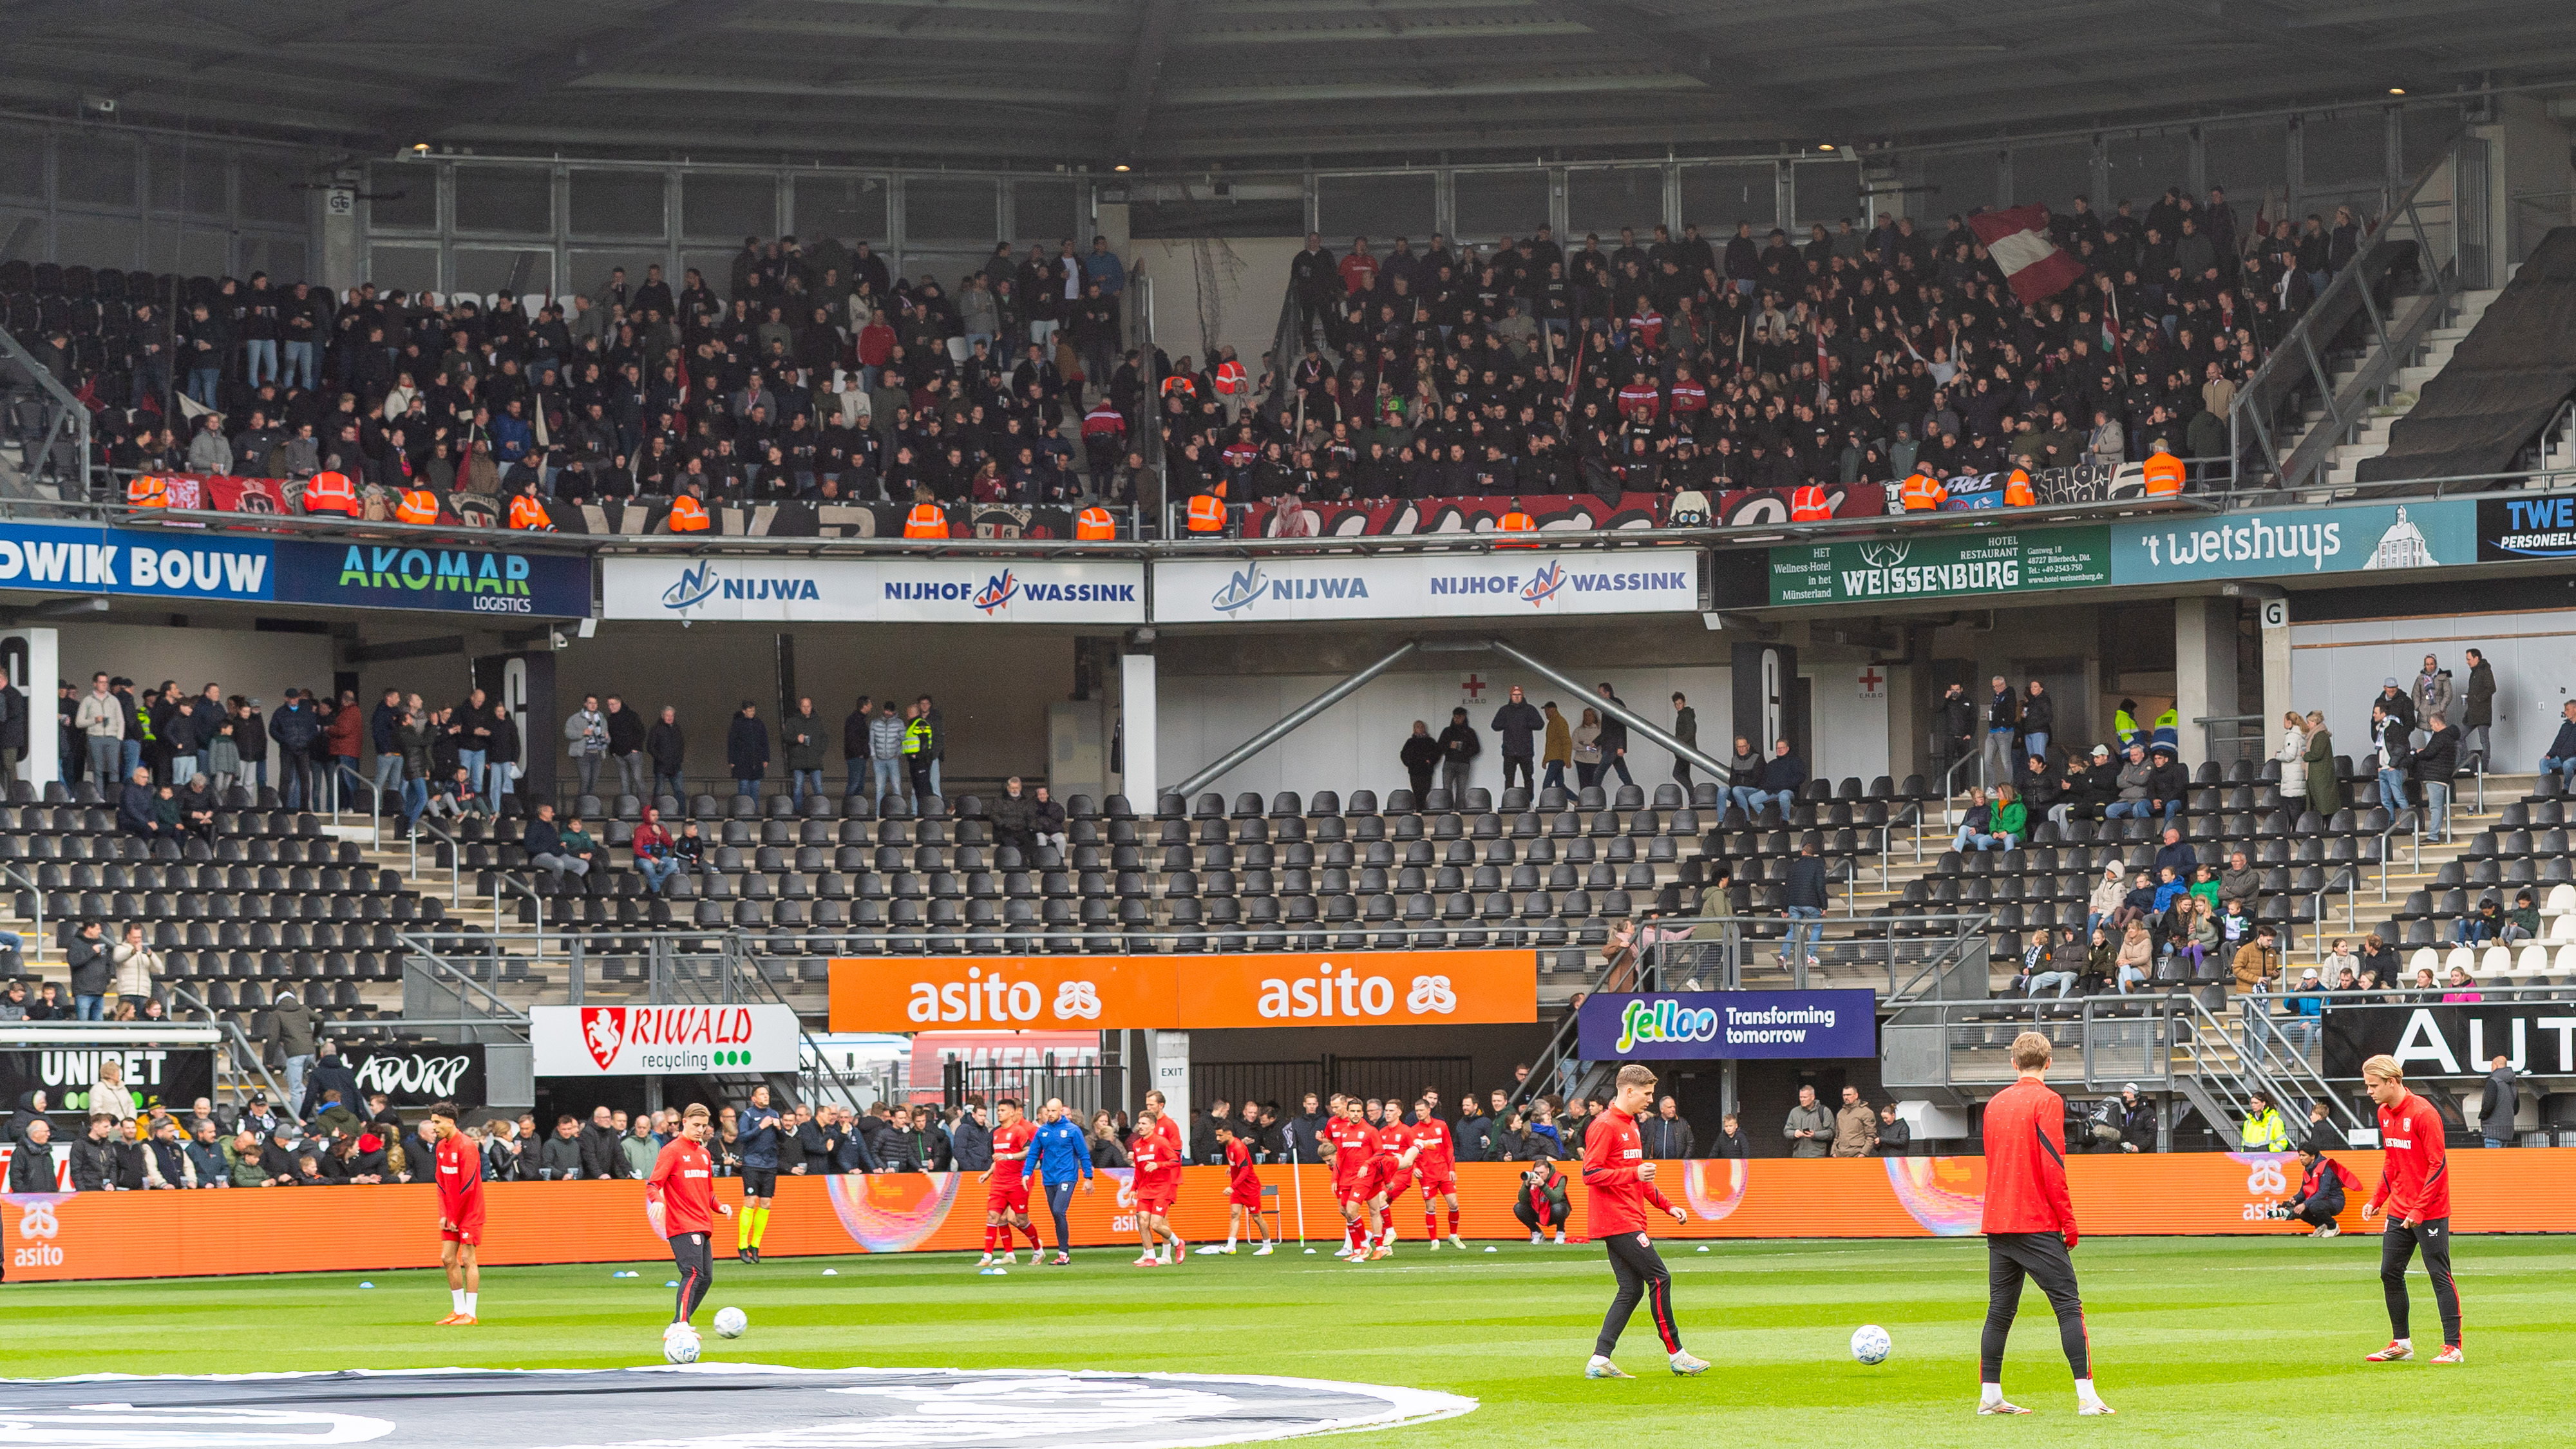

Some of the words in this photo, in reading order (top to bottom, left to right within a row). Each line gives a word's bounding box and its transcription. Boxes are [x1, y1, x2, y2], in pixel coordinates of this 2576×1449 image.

[1944, 472, 1999, 493] FREE
[1988, 536, 2018, 546] HOTEL
[2168, 518, 2340, 571] wetshuys
[1814, 547, 1831, 558] HET
[1960, 547, 2018, 560] RESTAURANT
[130, 544, 267, 592] BOUW
[339, 545, 531, 596] AKOMAR
[1774, 561, 1831, 574] Wellness-Hotel
[1841, 560, 2019, 596] WEISSENBURG
[723, 578, 820, 600] NIJWA
[1273, 578, 1369, 600] NIJWA
[1430, 576, 1519, 594] NIJHOF
[1571, 572, 1686, 591] WASSINK
[1808, 575, 1816, 585] in
[1818, 575, 1832, 585] het
[885, 582, 972, 601] NIJHOF
[1023, 583, 1135, 602] WASSINK
[1783, 588, 1832, 600] Münsterland
[473, 596, 531, 613] LOGISTICS
[2266, 603, 2281, 624] G
[907, 967, 1041, 1022] asito
[1258, 962, 1394, 1018] asito
[630, 1007, 752, 1045] RIWALD
[1616, 999, 1718, 1054] felloo
[1725, 1005, 1835, 1028] Transforming
[1726, 1027, 1806, 1044] tomorrow
[642, 1049, 708, 1070] recycling
[1162, 1068, 1184, 1076] EXIT
[2242, 1197, 2279, 1221] asit
[1112, 1209, 1139, 1233] asit
[14, 1241, 63, 1267] asito
